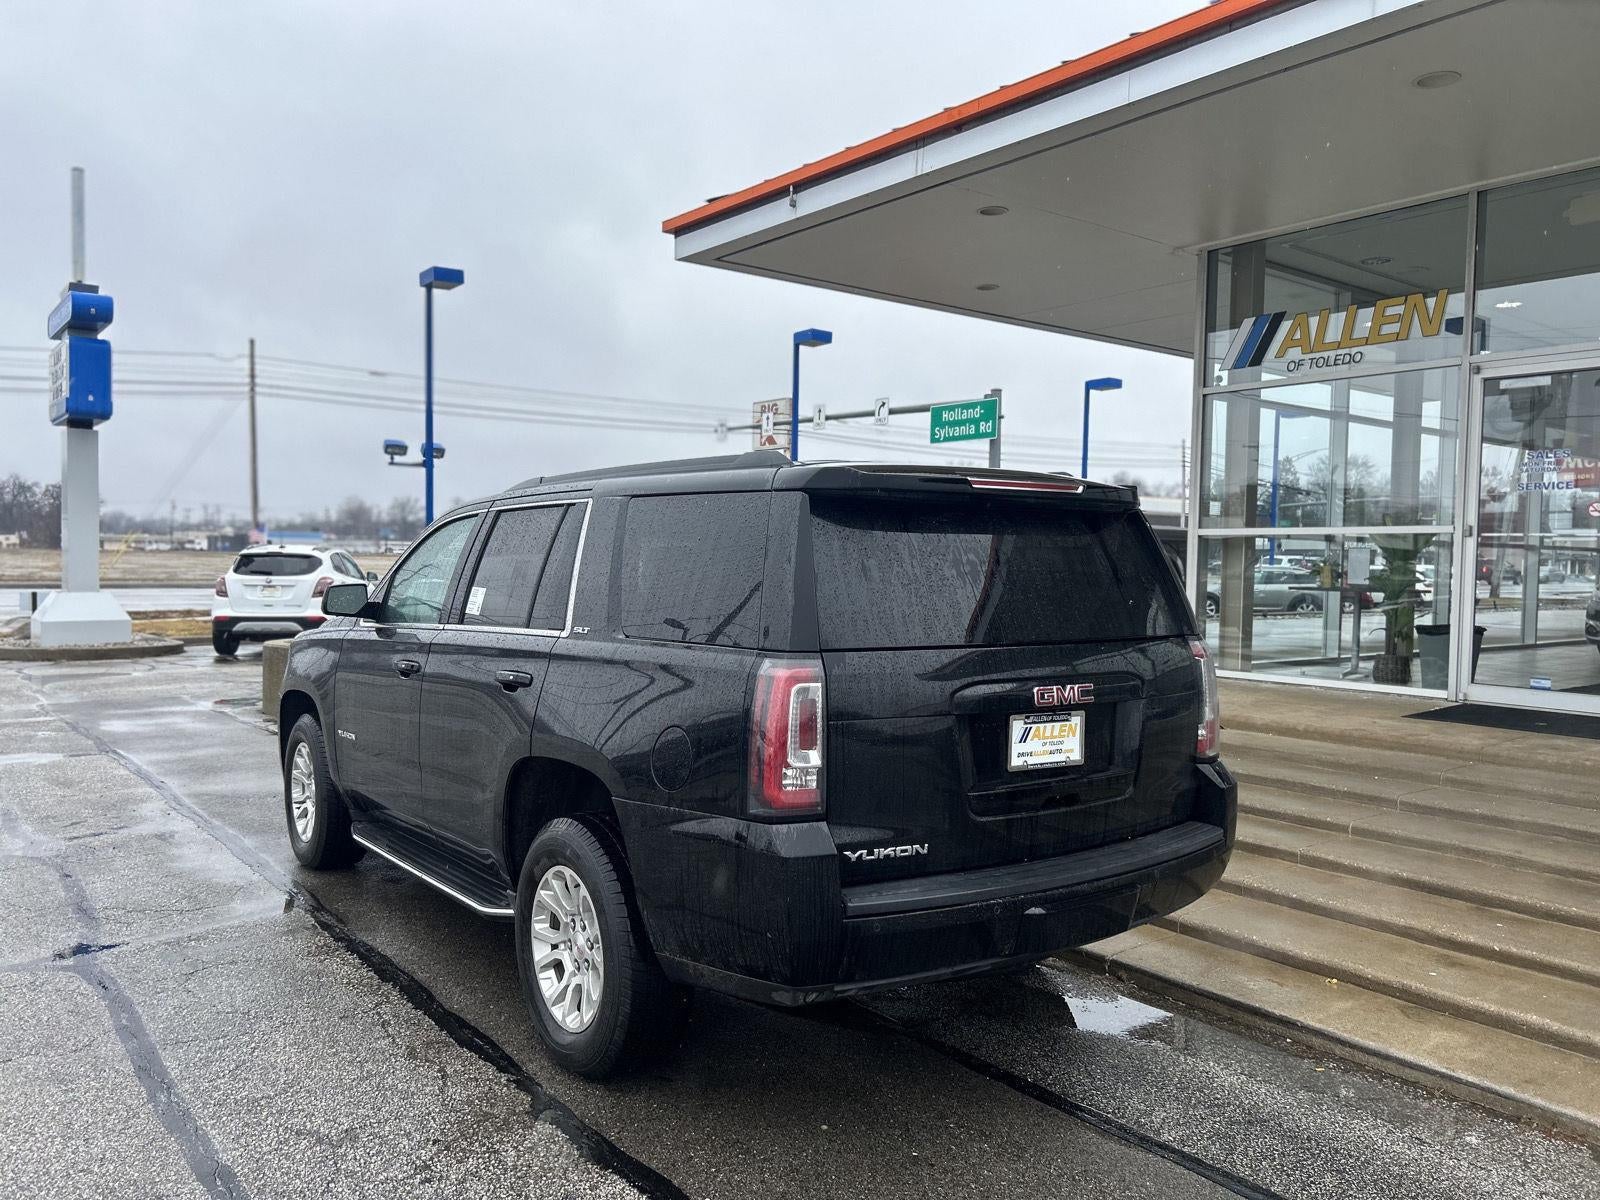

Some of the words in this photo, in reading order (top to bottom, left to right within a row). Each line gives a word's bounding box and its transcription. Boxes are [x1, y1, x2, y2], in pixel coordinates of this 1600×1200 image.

[1275, 288, 1449, 358] ALLEN
[1286, 359, 1306, 373] OF
[1308, 351, 1364, 369] TOLEDO
[942, 405, 984, 422] Holland-
[934, 423, 975, 440] Sylvania
[980, 420, 992, 433] Rd
[1527, 449, 1571, 460] SALES
[1518, 481, 1574, 491] SERVICE
[572, 626, 591, 634] SLT
[1034, 684, 1094, 707] GMC
[1031, 723, 1078, 741] ALLEN
[843, 843, 928, 861] YUKON
